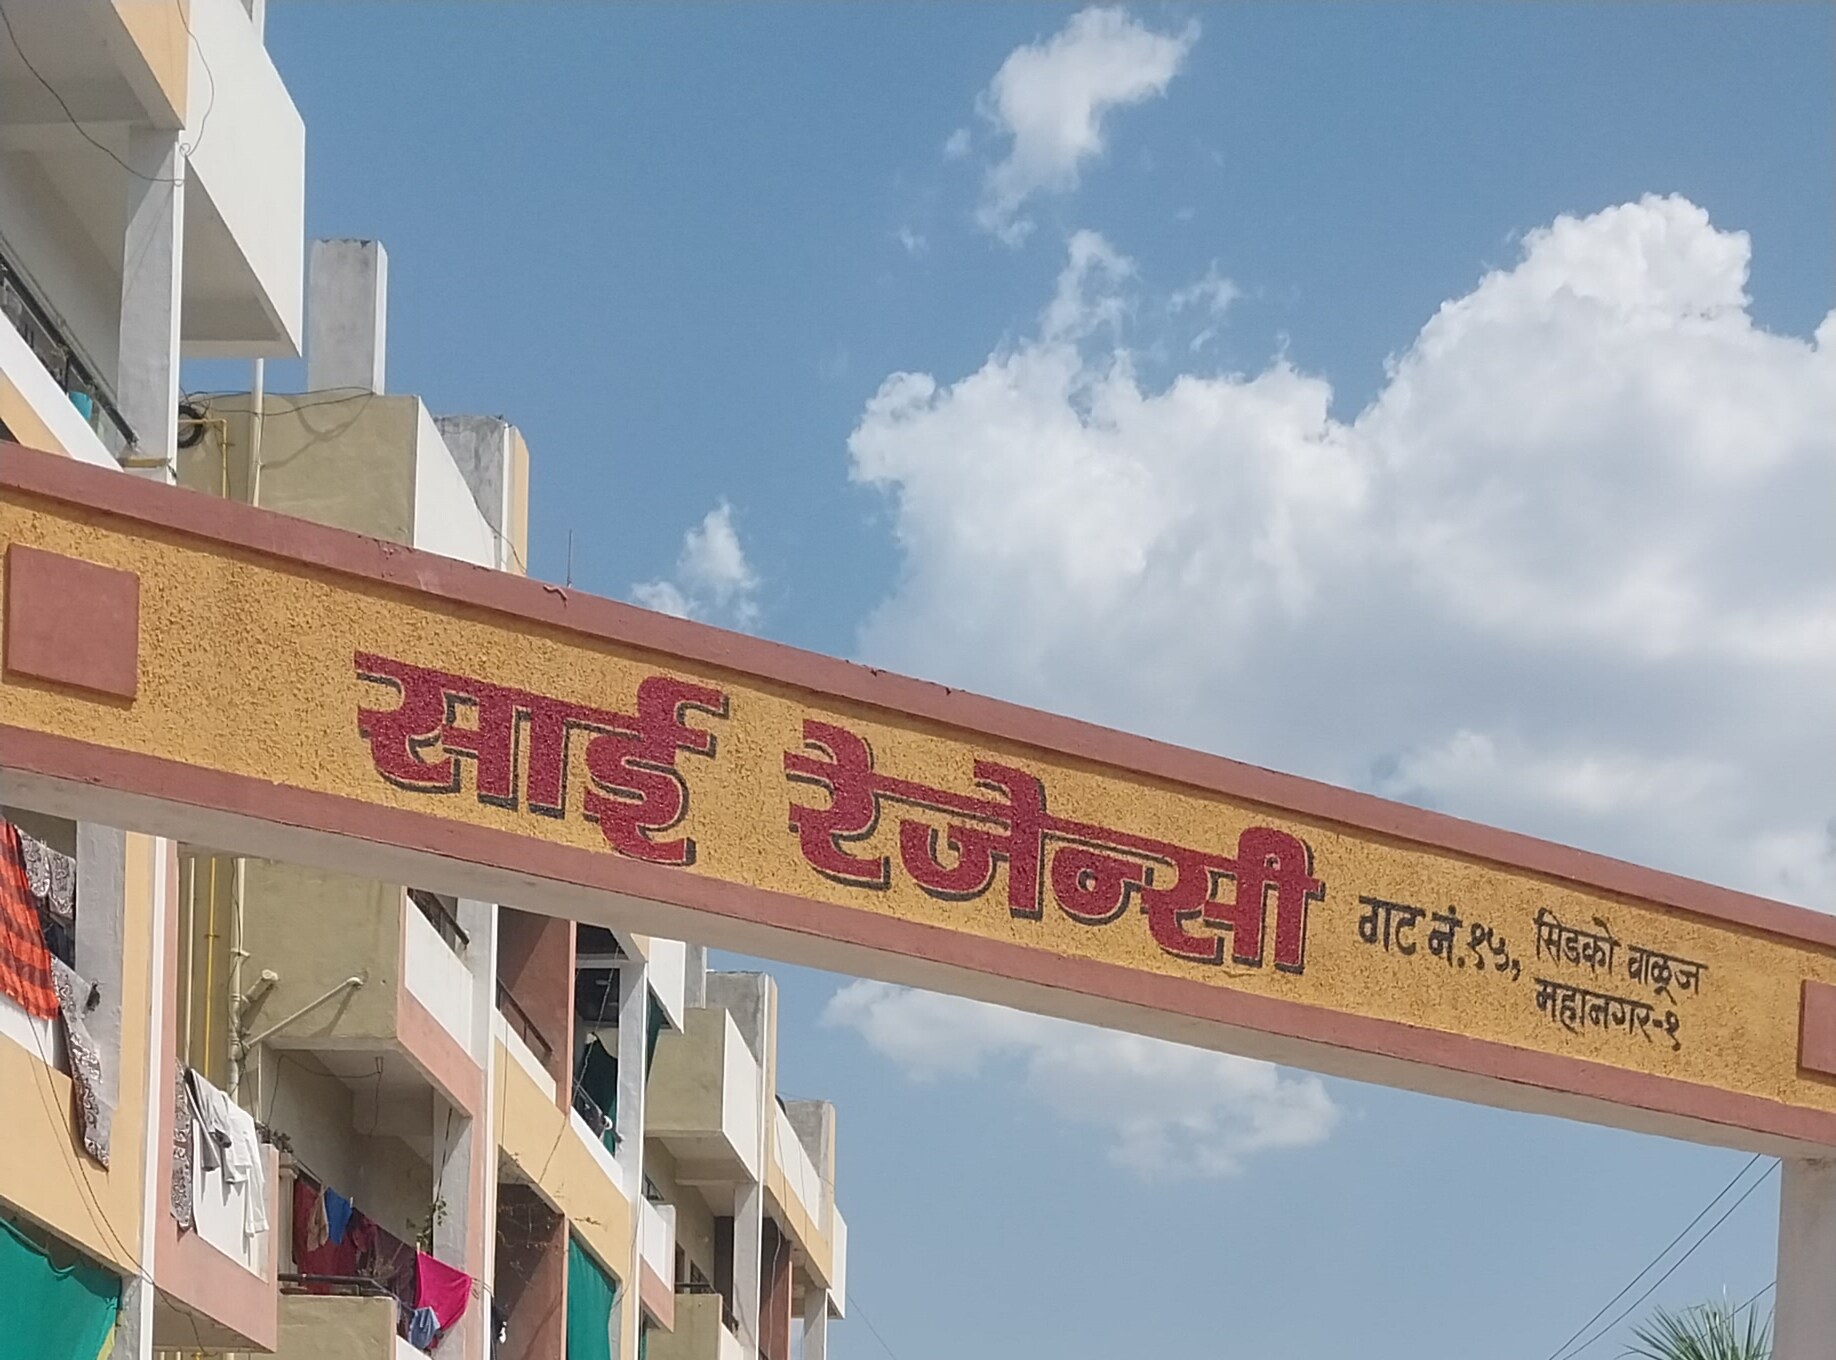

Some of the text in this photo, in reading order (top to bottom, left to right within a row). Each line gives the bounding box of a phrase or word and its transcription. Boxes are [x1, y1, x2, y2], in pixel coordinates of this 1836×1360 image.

[354, 650, 1325, 974] साई रेजेन्सी
[1359, 895, 1426, 956] गट
[1533, 907, 1709, 1006] सिडको वाळूज
[1533, 977, 1681, 1052] महानगर-१
